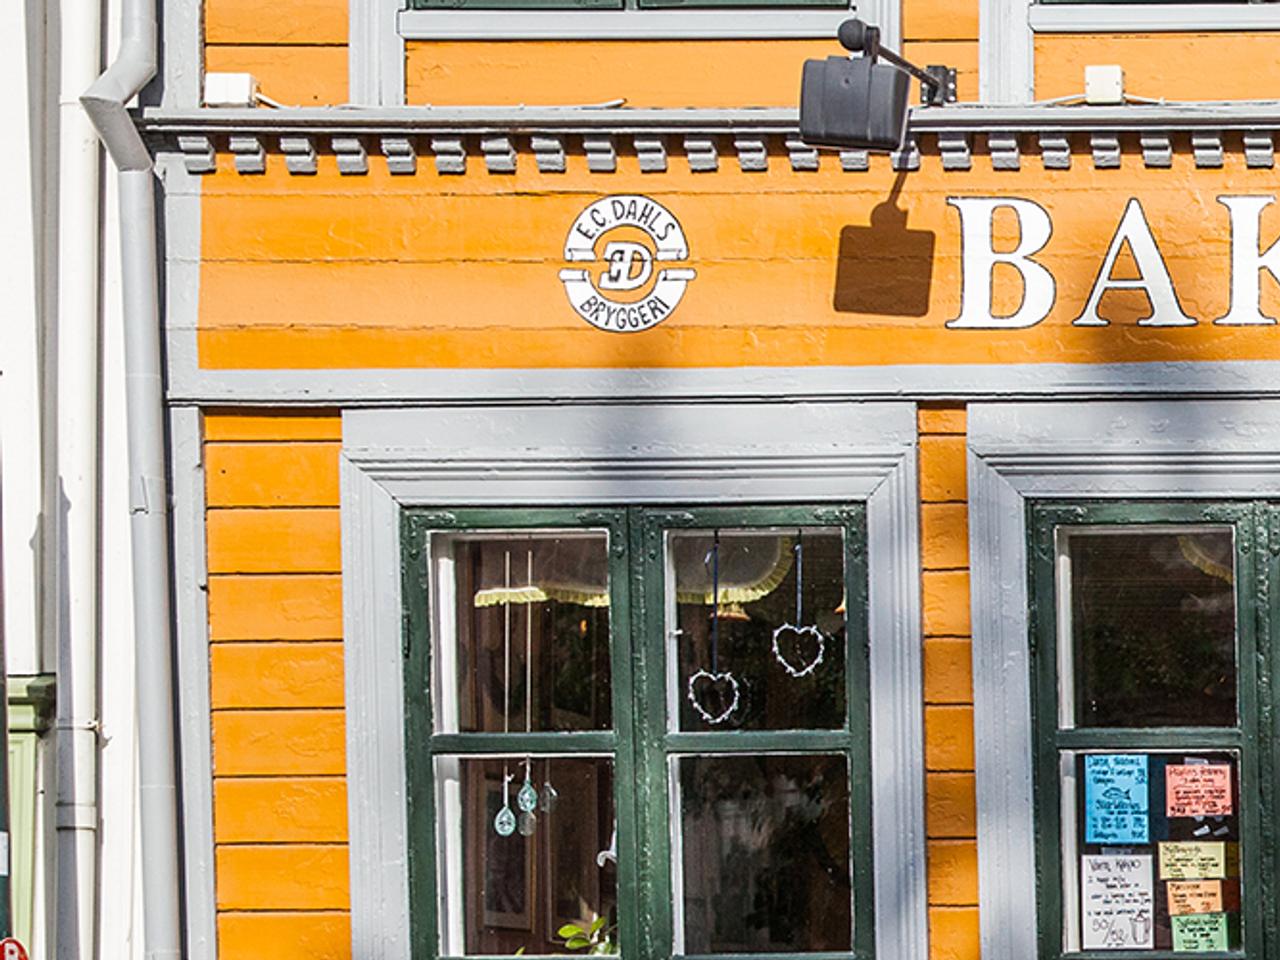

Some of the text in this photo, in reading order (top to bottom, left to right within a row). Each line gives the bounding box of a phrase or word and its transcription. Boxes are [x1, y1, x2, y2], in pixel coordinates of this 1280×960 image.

[576, 199, 675, 241] E.C. DAHLS
[580, 296, 670, 330] BRYGGERI
